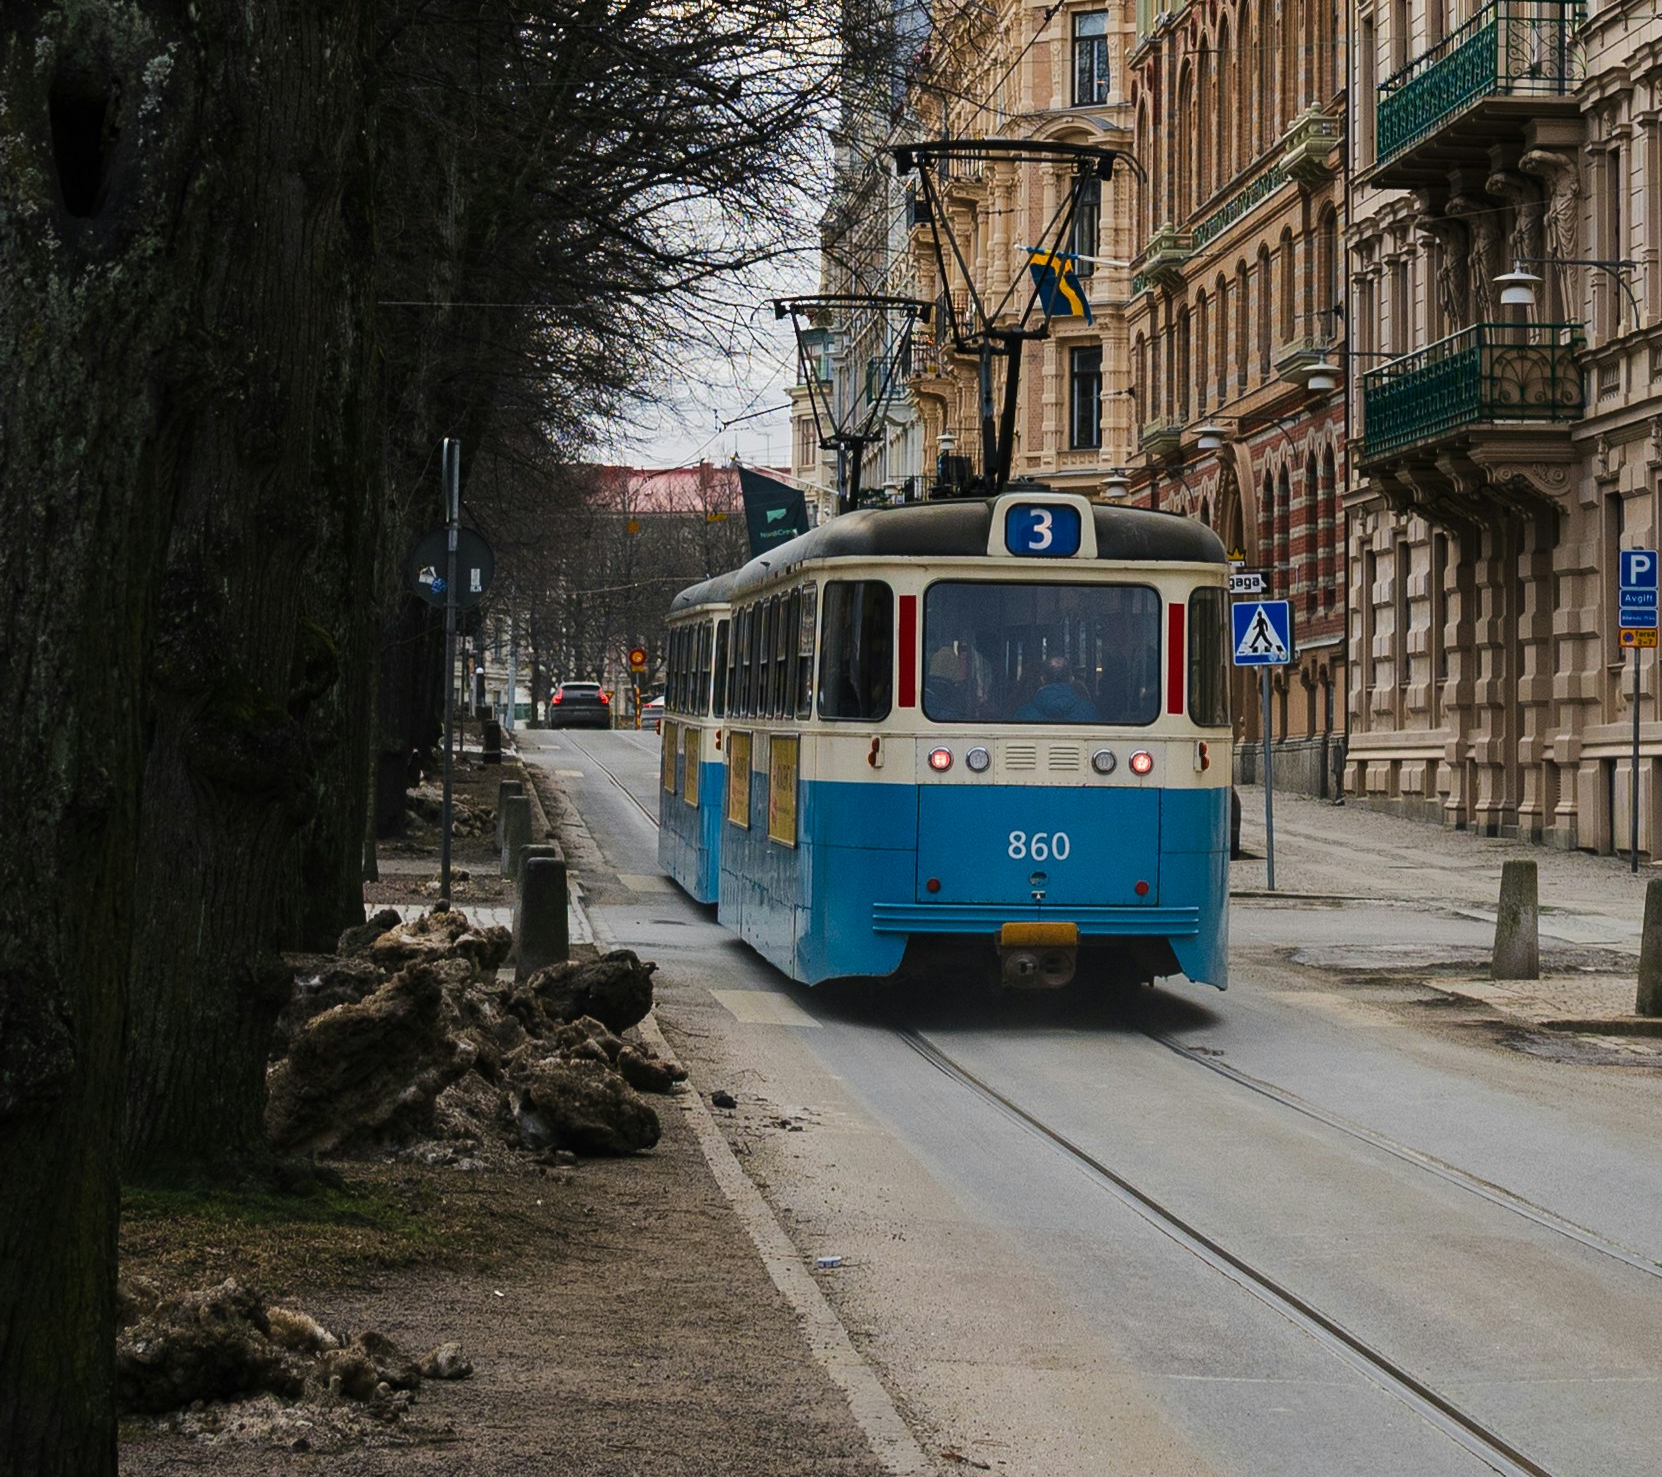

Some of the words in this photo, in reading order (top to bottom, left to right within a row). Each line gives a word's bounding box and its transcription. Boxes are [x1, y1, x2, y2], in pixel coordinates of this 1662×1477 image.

[1028, 508, 1053, 550] 3
[1630, 554, 1651, 585] P
[1624, 594, 1653, 603] Avgift
[1007, 830, 1071, 862] 860
